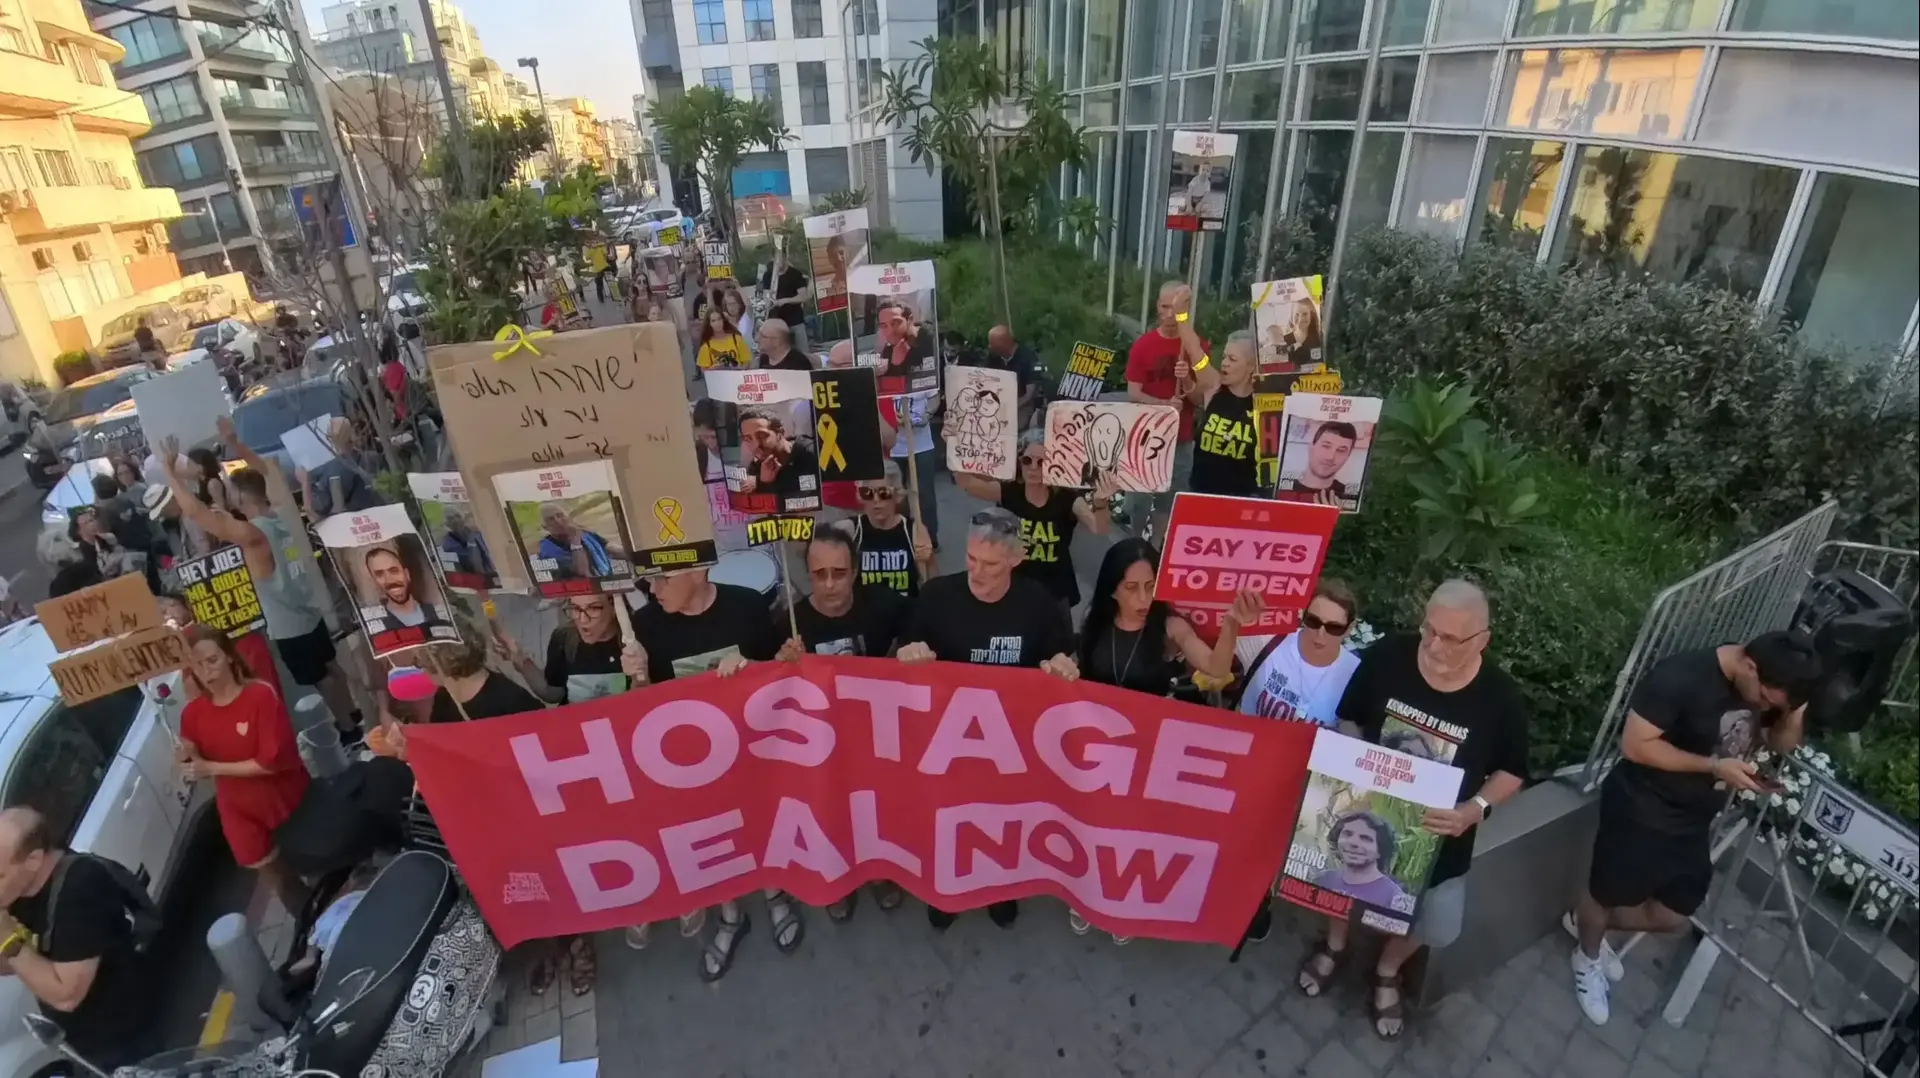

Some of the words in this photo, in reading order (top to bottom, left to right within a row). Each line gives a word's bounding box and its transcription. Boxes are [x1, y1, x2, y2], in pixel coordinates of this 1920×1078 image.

[857, 354, 881, 366] BRING
[1070, 354, 1110, 379] HOME
[1060, 374, 1104, 400] NOW!
[1203, 413, 1252, 444] SEAL
[1200, 431, 1247, 460] DEAL
[747, 519, 777, 545] מיד!
[862, 551, 879, 571] הם
[881, 549, 908, 570] למה
[1184, 536, 1244, 558] SAY
[1253, 541, 1308, 563] YES
[178, 559, 208, 586] HEY
[211, 547, 245, 575] JOE!
[211, 566, 250, 594] BIDEN
[1167, 568, 1208, 590] TO
[1216, 572, 1310, 597] BIDEN
[192, 592, 232, 623] HELP
[233, 582, 257, 607] US
[1385, 698, 1428, 725] KIDNAPPED
[1426, 714, 1440, 730] BY
[1438, 718, 1470, 741] HAMAS
[510, 676, 1254, 816] HOSTAGE
[1355, 757, 1375, 772] OFER
[556, 791, 921, 914] DEAL
[955, 820, 1195, 905] NOW
[1288, 843, 1327, 869] BRING
[1284, 858, 1309, 881] HIM
